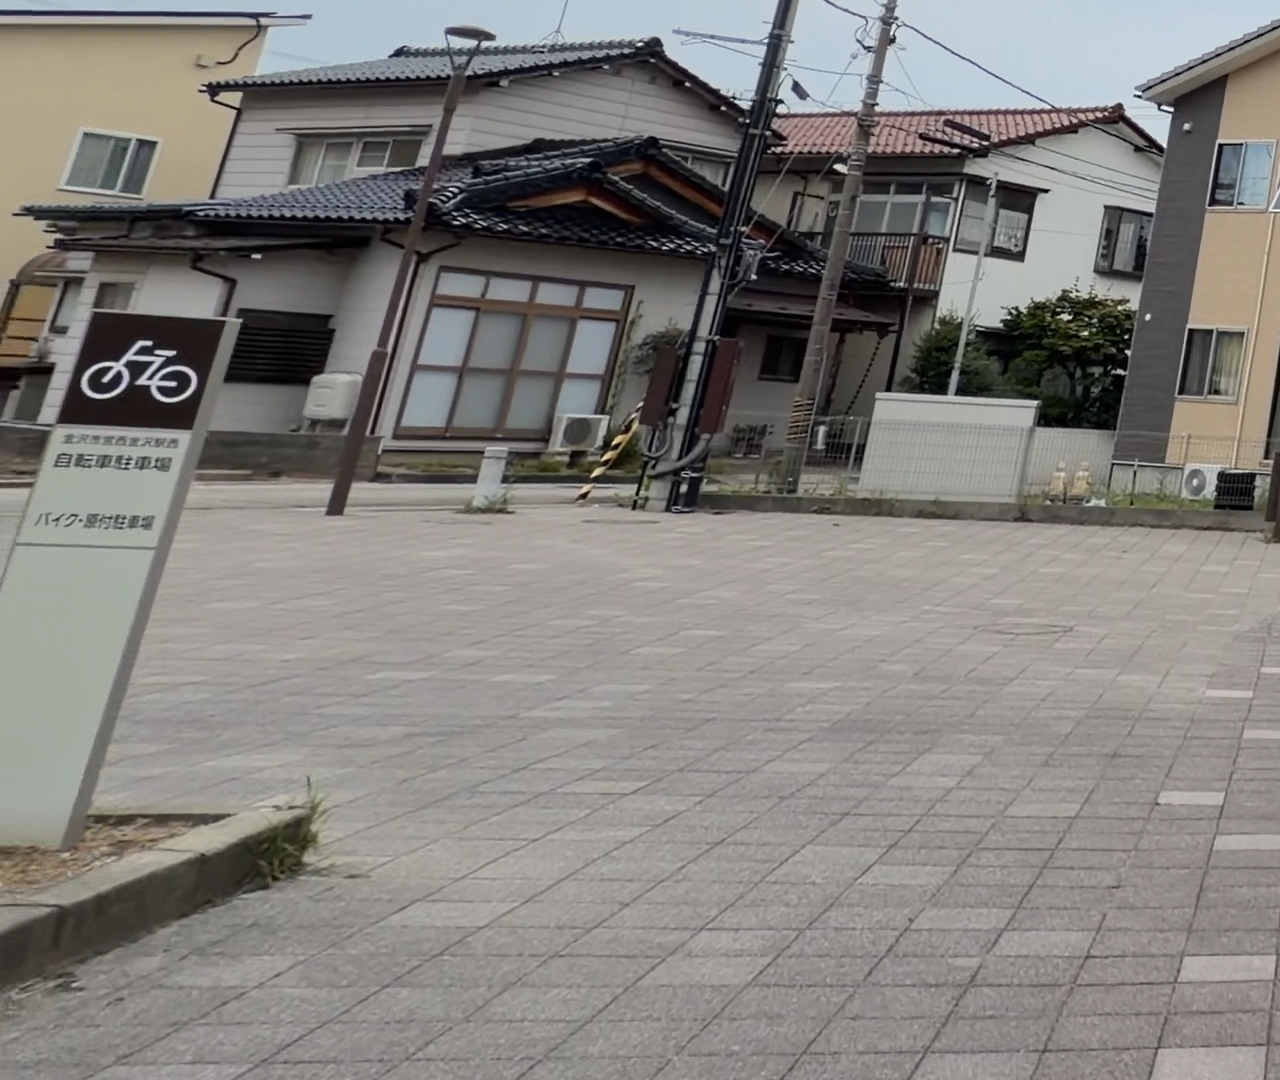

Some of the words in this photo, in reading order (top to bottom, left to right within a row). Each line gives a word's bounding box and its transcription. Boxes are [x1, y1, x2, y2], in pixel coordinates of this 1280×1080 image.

[53, 452, 173, 473] 自転車駐車場
